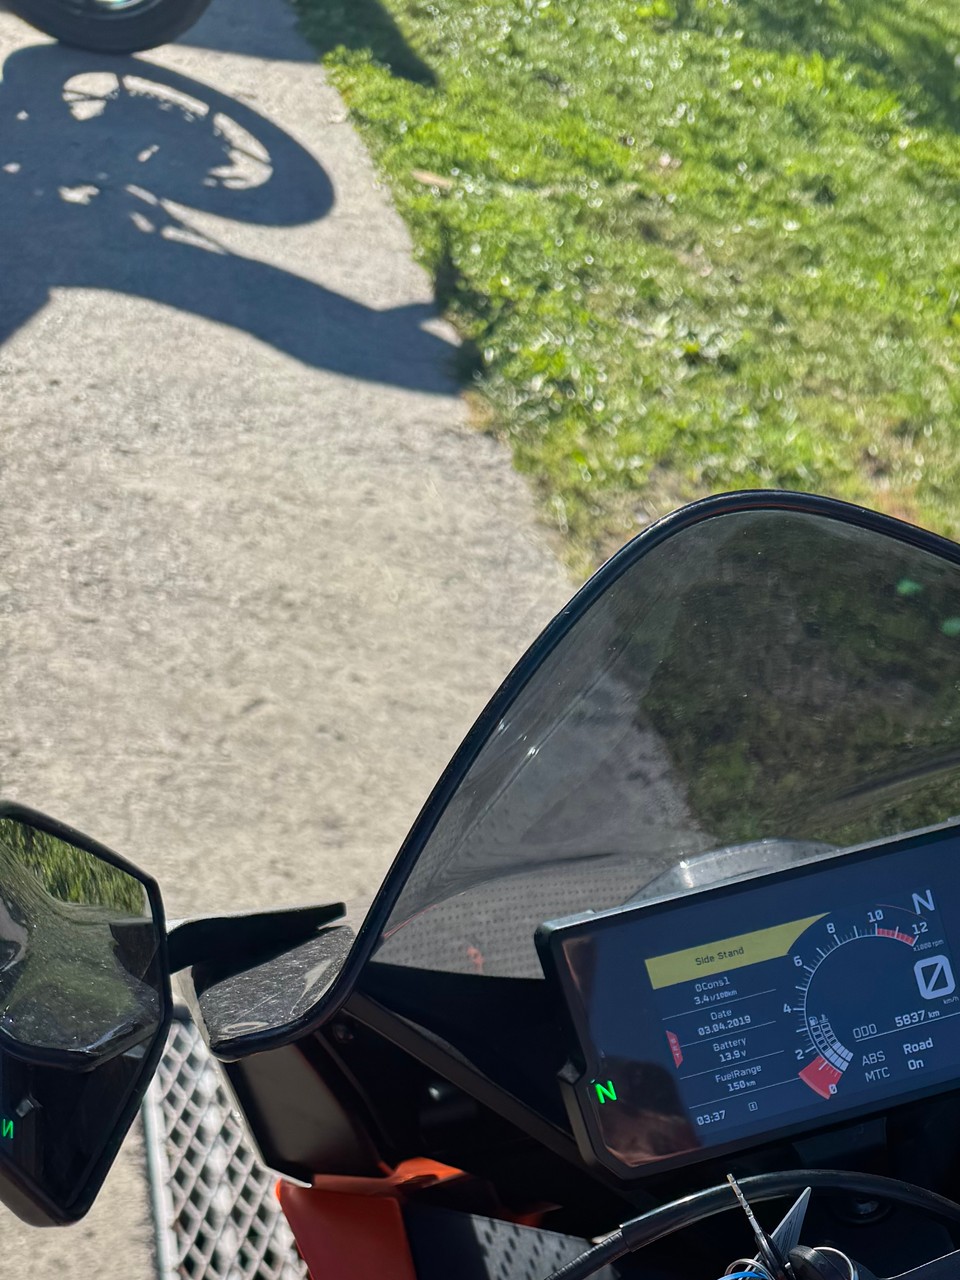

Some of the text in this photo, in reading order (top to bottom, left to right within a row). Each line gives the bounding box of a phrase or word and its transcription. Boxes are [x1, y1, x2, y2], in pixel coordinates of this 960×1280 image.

[912, 889, 936, 915] N
[867, 909, 884, 923] 10
[826, 922, 836, 934] 8
[911, 921, 929, 935] 12
[695, 946, 745, 967] Side Stand
[793, 955, 803, 967] 6
[710, 1009, 732, 1021] Date
[783, 1003, 792, 1014] 4
[697, 1014, 752, 1036] 03.04.2019
[852, 1009, 940, 1040] ODO 5837 km
[712, 1037, 747, 1052] Battery
[862, 1037, 934, 1067] ABS Road
[795, 1049, 805, 1060] 2
[714, 1064, 762, 1083] FuelRange
[865, 1058, 925, 1083] MTC On
[594, 1080, 618, 1104] N
[727, 1079, 746, 1093] 150
[828, 1084, 838, 1095] 0
[696, 1109, 727, 1126] 03:37
